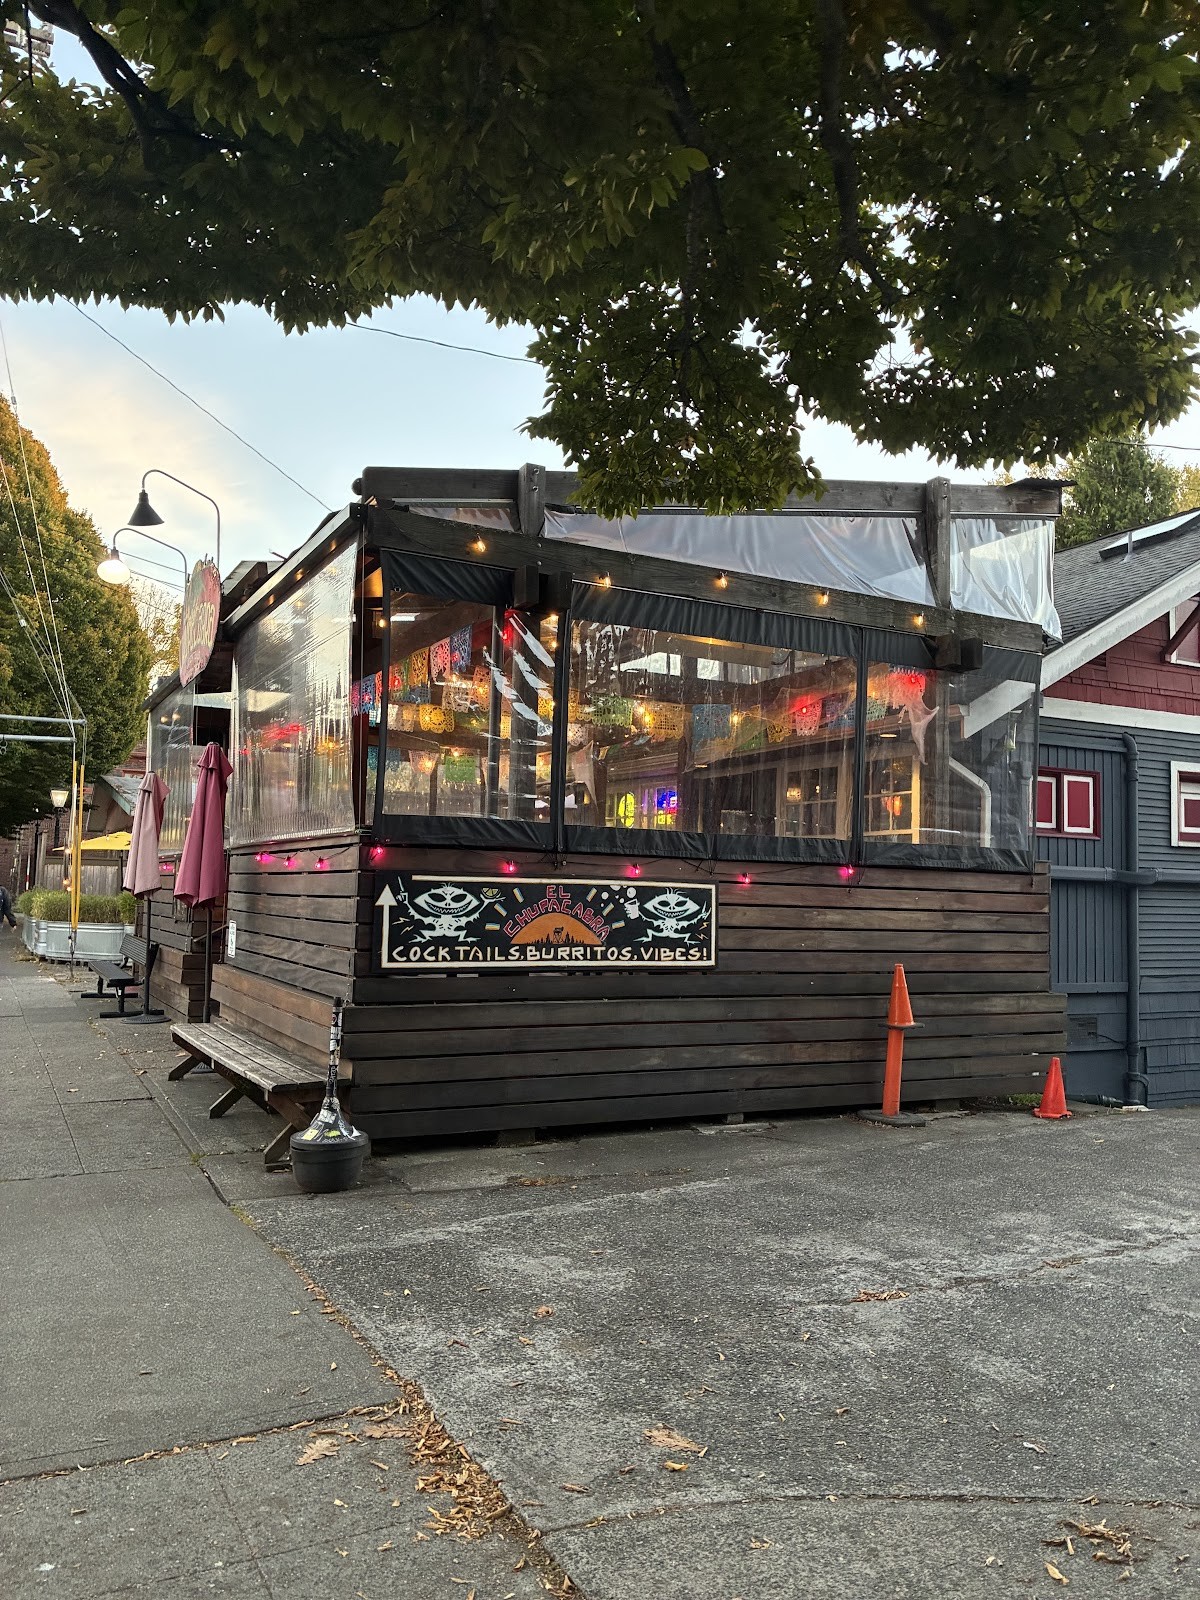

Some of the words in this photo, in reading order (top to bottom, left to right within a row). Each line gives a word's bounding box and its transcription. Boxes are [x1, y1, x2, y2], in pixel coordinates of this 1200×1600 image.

[546, 885, 570, 898] EL
[503, 899, 610, 941] CHUPACABRA
[526, 945, 637, 961] BURRITOS,
[640, 946, 707, 961] VIBES!
